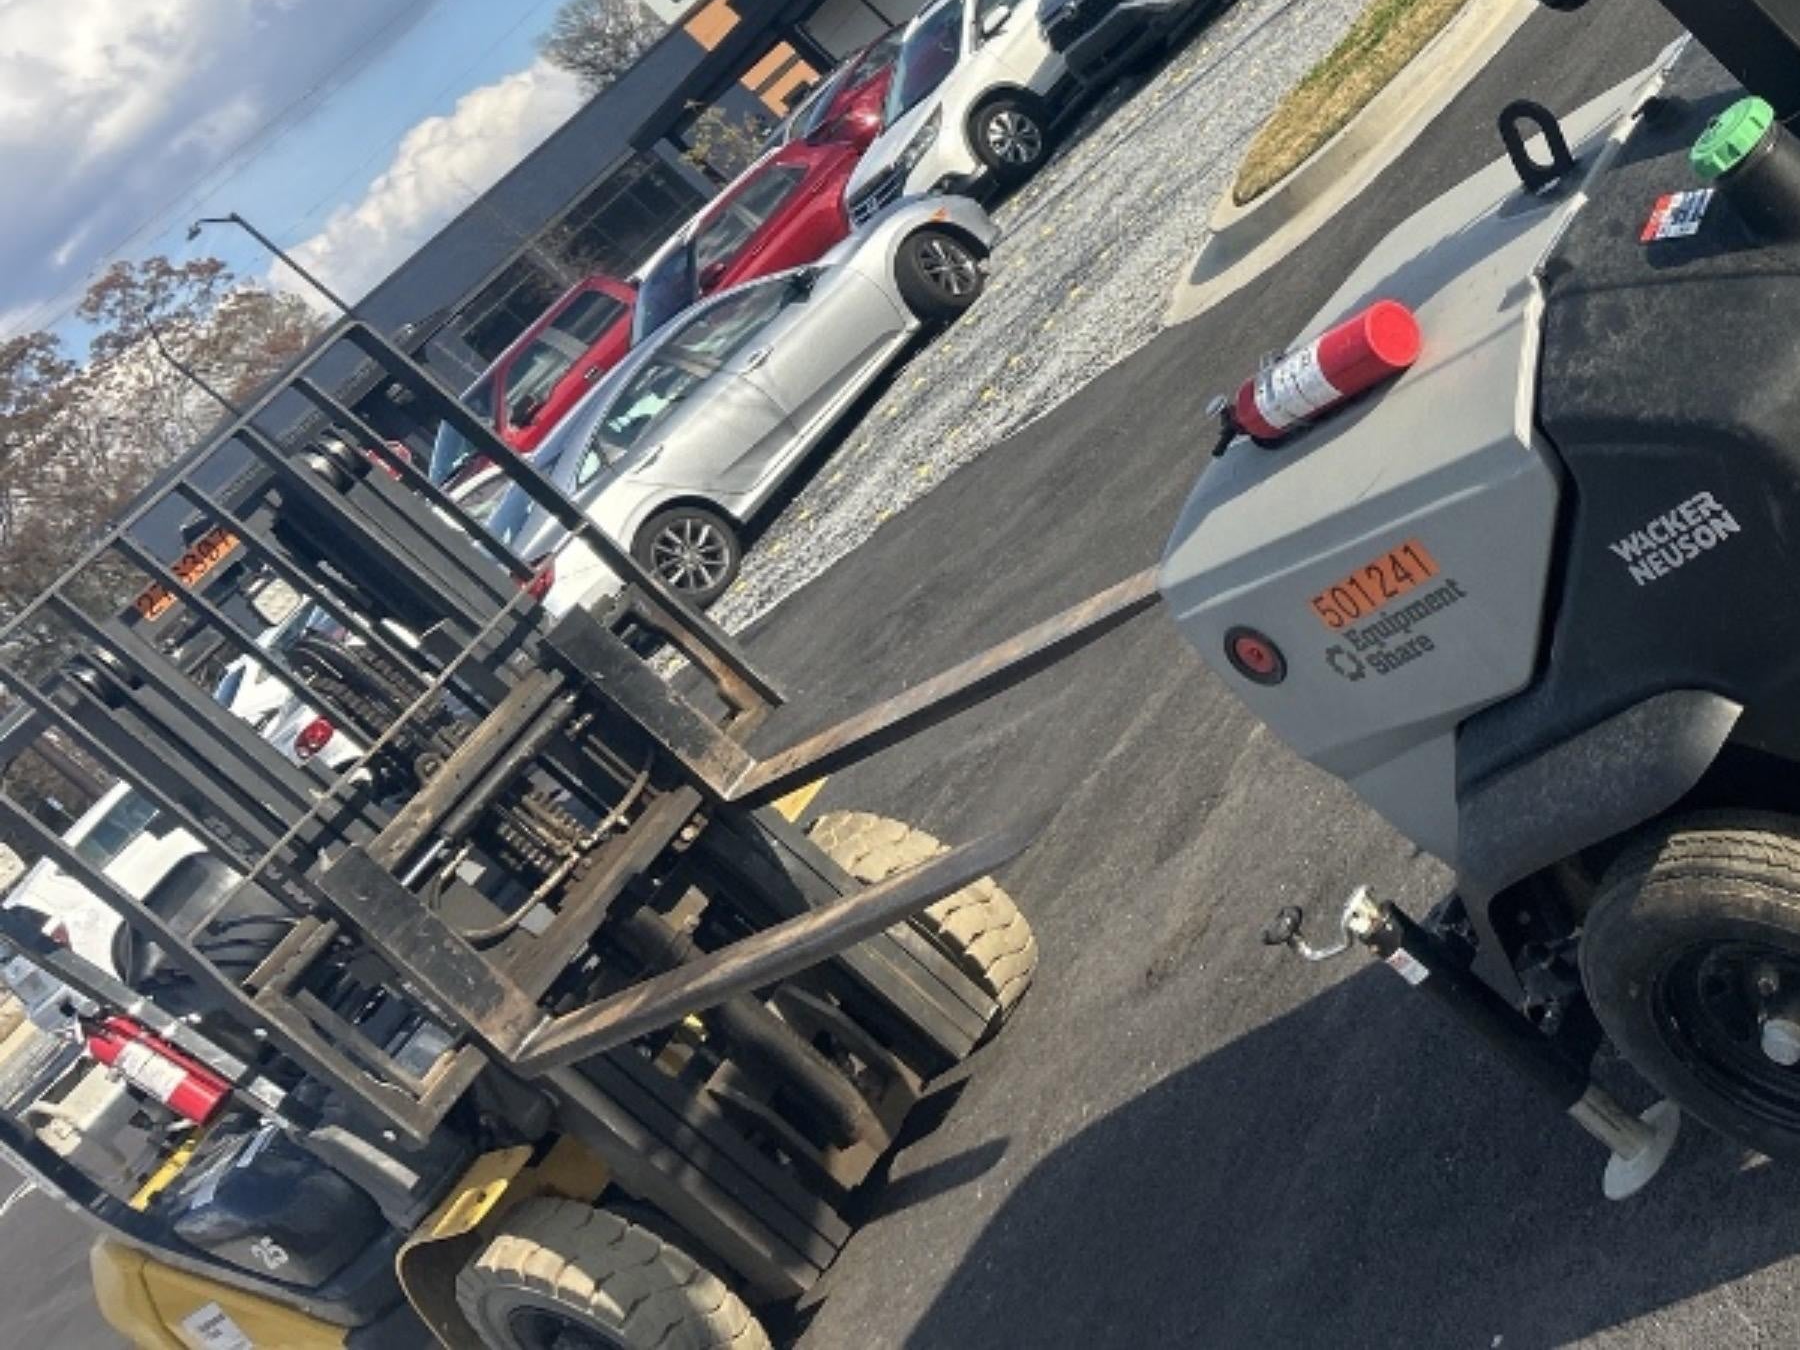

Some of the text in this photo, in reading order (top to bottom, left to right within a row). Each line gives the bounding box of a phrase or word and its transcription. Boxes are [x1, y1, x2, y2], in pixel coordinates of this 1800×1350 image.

[1608, 491, 1723, 562] WACKER
[1628, 509, 1741, 586] NEUSON
[1312, 544, 1432, 629] 501241
[1342, 578, 1467, 652] Equipment
[1365, 635, 1435, 675] Share
